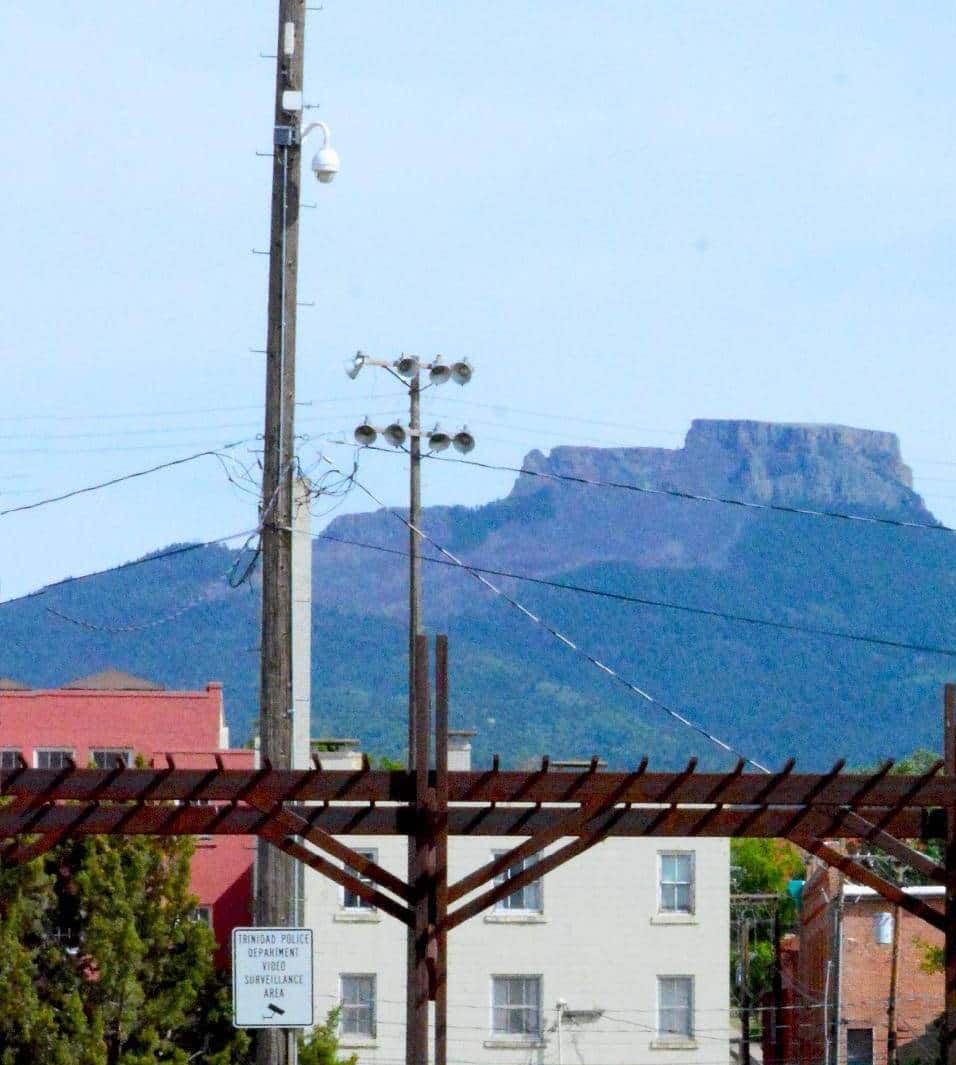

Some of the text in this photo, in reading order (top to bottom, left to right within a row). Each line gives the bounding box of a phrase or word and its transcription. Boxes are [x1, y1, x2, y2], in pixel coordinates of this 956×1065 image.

[238, 934, 310, 944] TRINIDAD POLICE
[248, 947, 298, 957] DEPARTMENT
[262, 961, 286, 971] VIDEO
[244, 975, 304, 985] SURVEILLANCE
[263, 988, 285, 998] AREA
